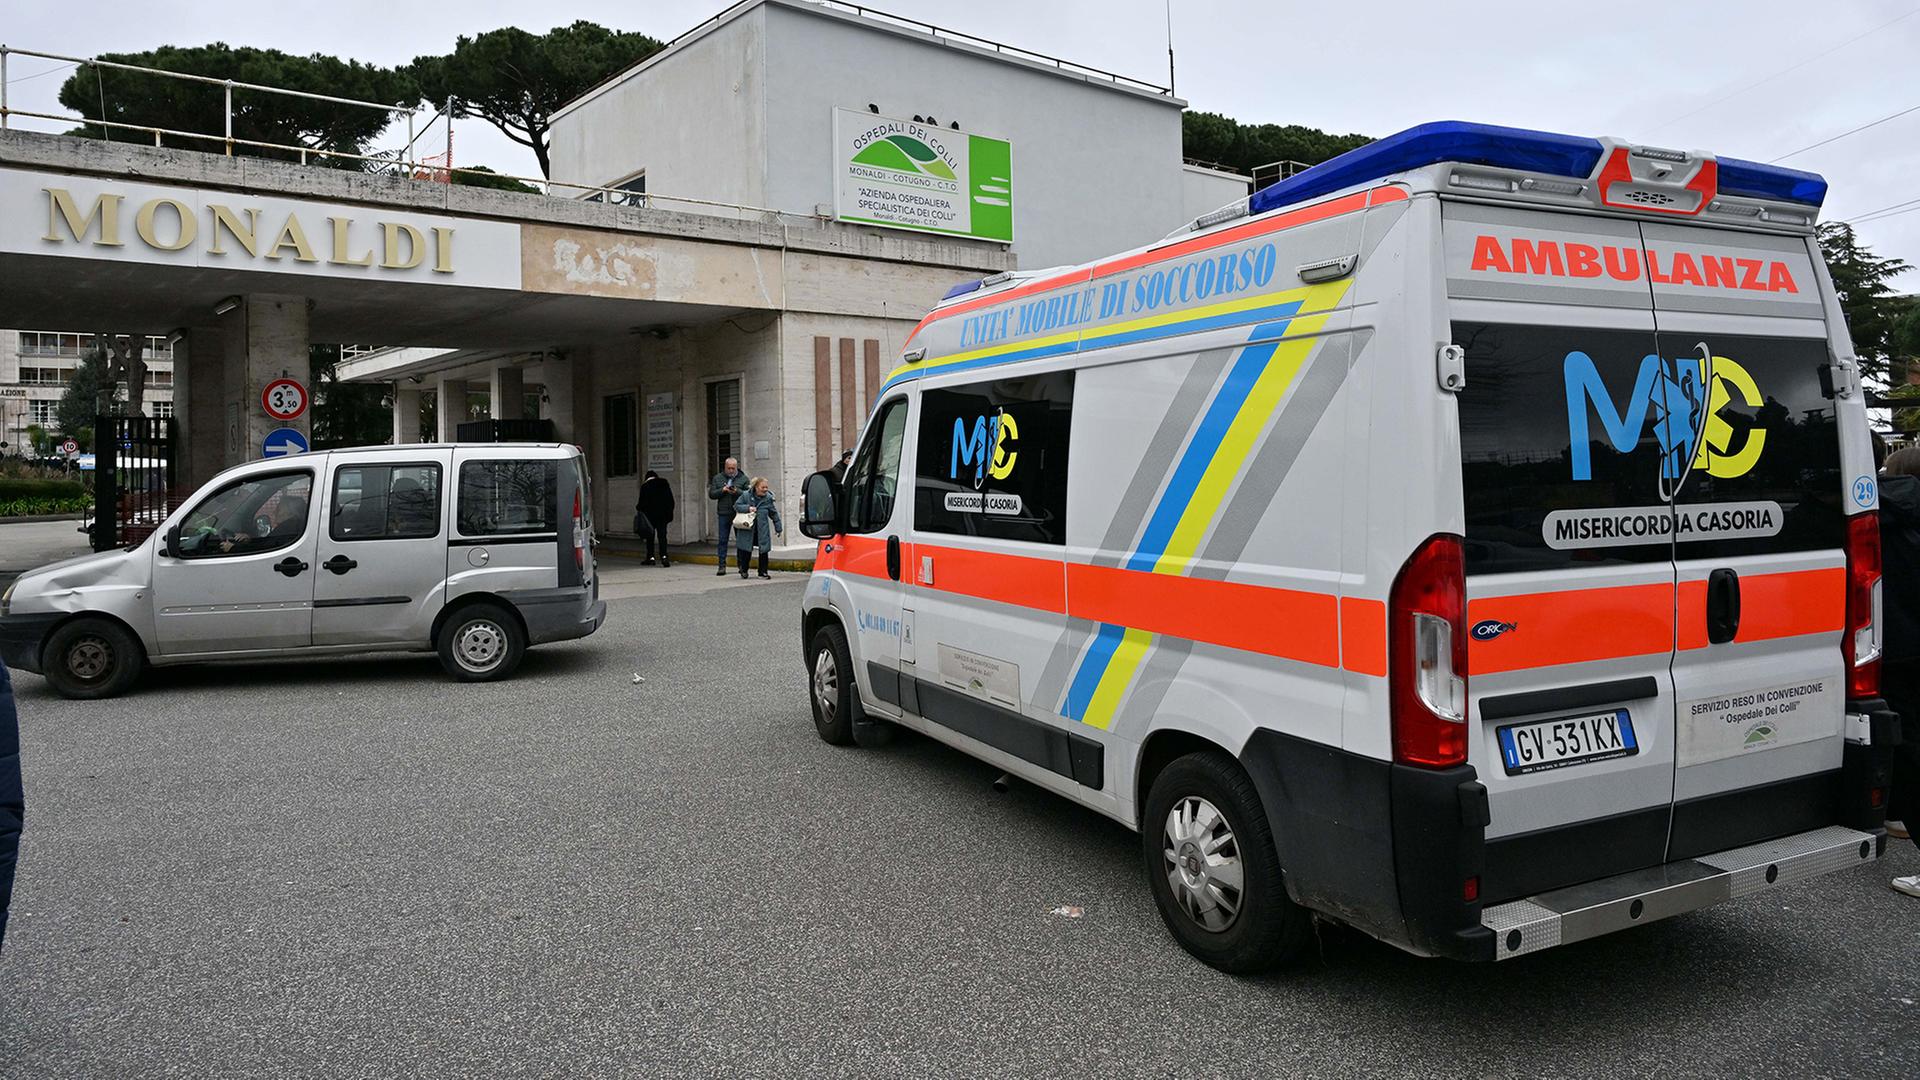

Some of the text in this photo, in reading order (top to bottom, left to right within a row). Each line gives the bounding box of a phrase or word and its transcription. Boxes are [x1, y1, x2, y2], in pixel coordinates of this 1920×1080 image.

[853, 123, 958, 170] OSPEDALI DEI COLLI
[849, 167, 886, 180] MONALDI
[893, 174, 931, 187] COTUGNO
[937, 181, 959, 191] C.T.O.
[858, 199, 915, 216] SPECIALISTICA
[917, 208, 930, 218] DEI
[898, 193, 951, 209] OSPEDALIERA
[873, 212, 894, 220] Monaldi
[898, 216, 920, 225] Cotugno
[41, 188, 456, 273] MONALDI
[1470, 235, 1799, 294] AMBULANZA
[959, 243, 1277, 348] UNITA' MOBILE DI SOCCORSO
[273, 391, 284, 408] 3
[1857, 482, 1873, 500] 29
[990, 498, 1018, 511] CASORIA
[1555, 509, 1774, 541] MISERICORDIA CASORIA
[1691, 682, 1823, 715] SERVIZIO RESO IN CONVENZIONE
[1726, 708, 1763, 724] Ospedale
[1765, 704, 1778, 716] Dei
